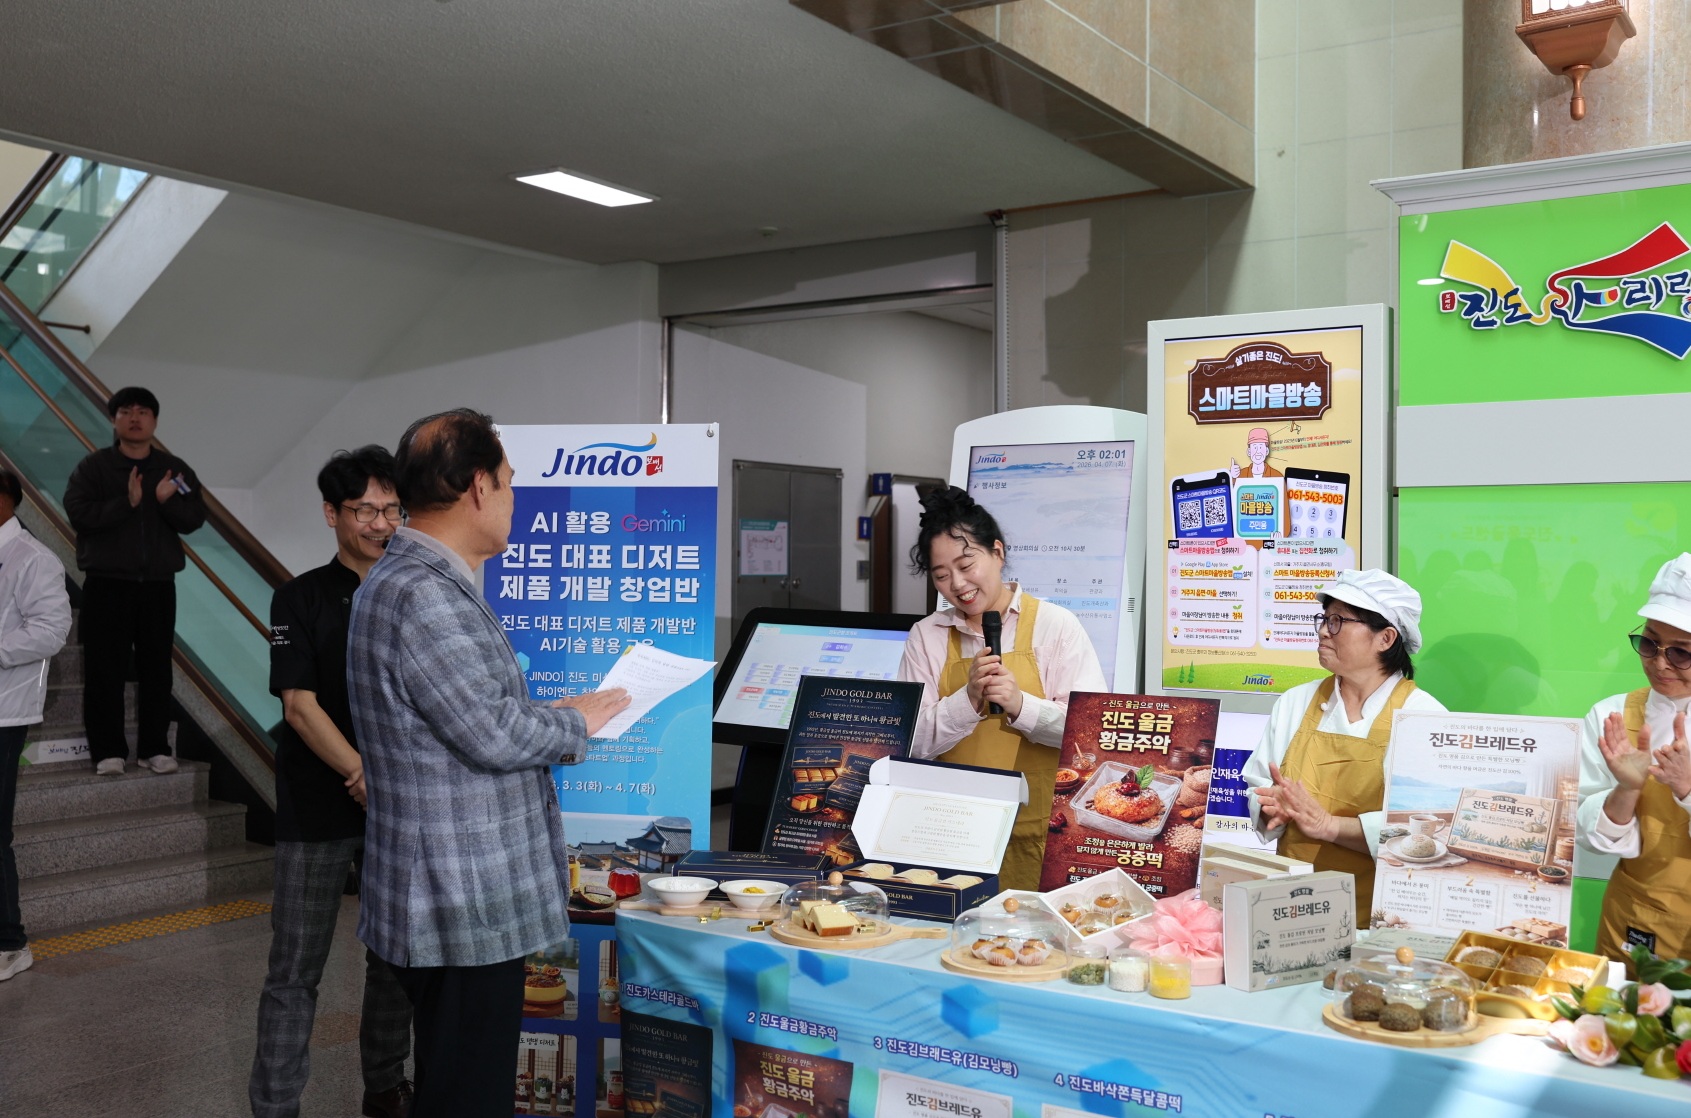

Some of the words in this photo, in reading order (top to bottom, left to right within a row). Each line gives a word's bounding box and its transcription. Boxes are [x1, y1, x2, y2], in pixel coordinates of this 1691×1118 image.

[1459, 287, 1532, 328] 진도
[1235, 350, 1264, 367] 살기좋은
[1265, 350, 1283, 364] 진도!
[1198, 381, 1322, 411] 스마트마을방송
[541, 447, 643, 478] Jindo
[975, 455, 1001, 465] Jindo
[1077, 449, 1096, 460] 오후
[1099, 449, 1126, 459] 02:01
[981, 481, 1007, 489] 행사정보
[1288, 489, 1343, 505] 061-543-5003
[1240, 501, 1274, 515] 마을방송
[530, 511, 558, 533] AI
[565, 511, 611, 534] 활용
[621, 513, 686, 533] Gemini
[502, 543, 552, 568] 진도
[561, 544, 612, 569] 대표
[621, 544, 700, 570] 디저트
[1318, 547, 1338, 555] 청취하기
[1273, 569, 1289, 577] 스마트
[499, 575, 551, 601] 제품
[560, 576, 611, 602] 개발
[620, 577, 700, 603] 창업반
[501, 614, 531, 631] 진도
[534, 615, 564, 632] 대표
[568, 616, 612, 633] 디저트
[616, 617, 646, 634] 제품
[651, 617, 696, 635] 개발반
[540, 636, 588, 654] AI기술
[591, 637, 621, 655] 활용
[568, 671, 588, 684] 진도
[592, 672, 607, 684] 미
[1242, 675, 1268, 685] Jindo
[536, 686, 577, 698] 하이엔드
[821, 688, 848, 697] JINDO
[849, 689, 873, 699] GOLD
[874, 691, 893, 700] BAR
[1108, 700, 1124, 708] 진도
[1125, 701, 1153, 710] 울금으로
[1101, 711, 1135, 730] 진도
[1137, 713, 1174, 733] 울금
[1098, 731, 1171, 755] 황금주악
[1428, 732, 1538, 753] 진도김브레드유
[576, 781, 602, 793] 3(화)
[616, 782, 627, 792] 4.
[629, 782, 656, 795] 7(화)
[1472, 800, 1534, 818] 진도김브레드유
[1215, 820, 1238, 830] 감사의
[1106, 839, 1137, 849] 은은하게
[1138, 842, 1154, 851] 발라
[1076, 845, 1090, 854] 달지
[1104, 848, 1118, 857] 만든
[1116, 850, 1163, 868] 궁중떡
[1465, 875, 1474, 886] 2
[1528, 882, 1537, 893] 3
[901, 893, 914, 901] BAR
[1272, 900, 1331, 921] 진도김브레드유
[626, 983, 700, 1011] 진도카스테라골드바
[628, 1022, 650, 1034] JINDO
[651, 1027, 672, 1038] GOLD
[673, 1033, 688, 1042] BAR
[747, 1011, 756, 1023] 2
[759, 1012, 838, 1041] 진도울금황금주악
[874, 1037, 883, 1049] 3
[886, 1038, 1018, 1077] 진도김브래드유(김모닝빵)
[760, 1060, 786, 1079] 진도
[787, 1065, 815, 1086] 울금
[762, 1077, 815, 1107] 황금주악
[1054, 1073, 1065, 1086] 4
[1068, 1075, 1182, 1112] 진도바삭쫀득달콤떡
[906, 1092, 983, 1118] 진도김브레드유
